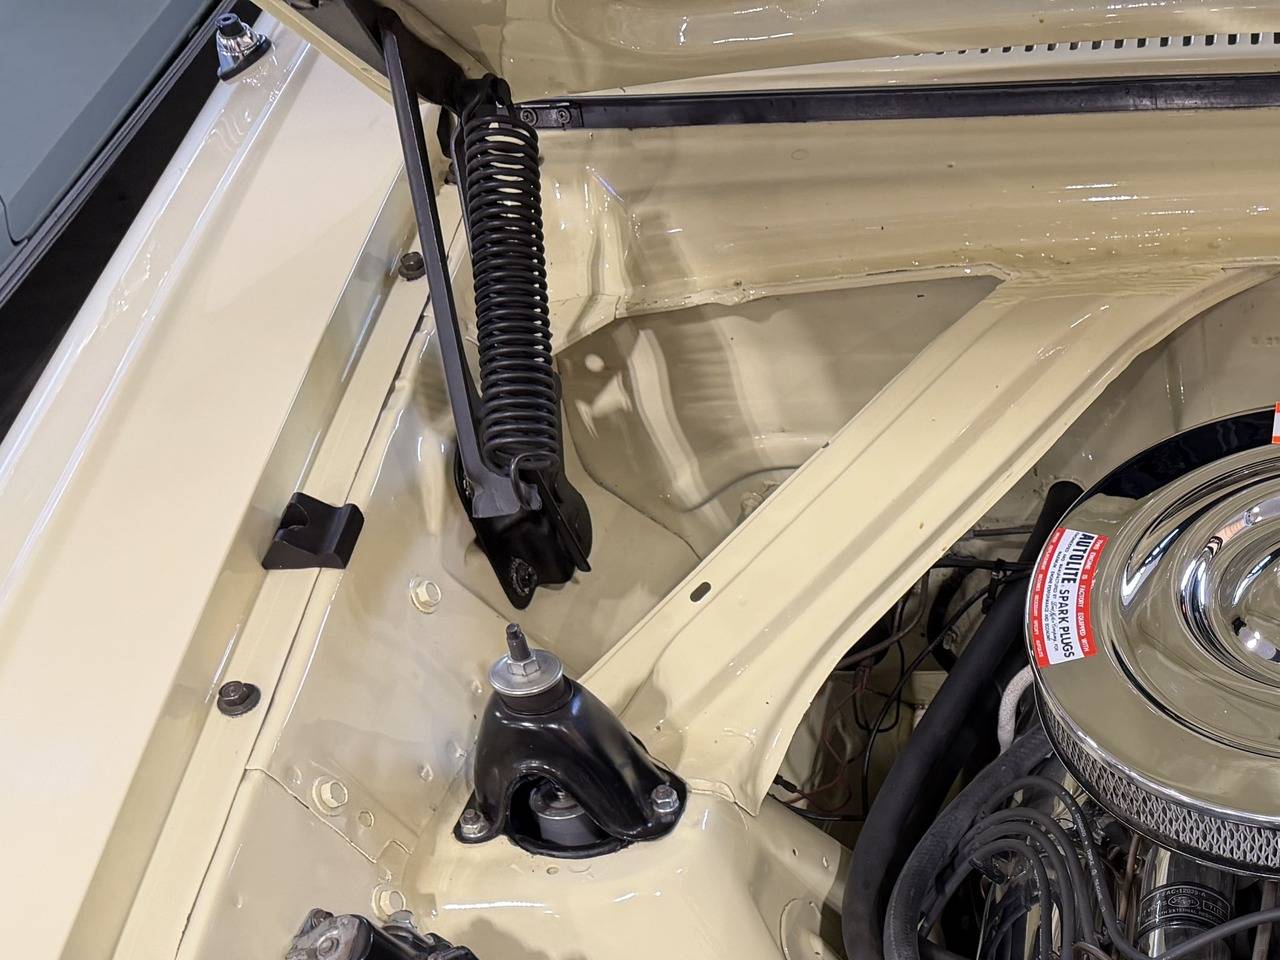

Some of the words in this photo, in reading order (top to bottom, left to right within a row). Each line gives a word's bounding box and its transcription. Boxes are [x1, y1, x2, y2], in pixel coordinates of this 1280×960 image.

[1061, 534, 1094, 584] AUTOLITE
[1093, 539, 1103, 550] THIS
[1084, 552, 1096, 570] ENGINE
[1058, 589, 1070, 624] SPARK
[1059, 626, 1075, 658] PLUGS
